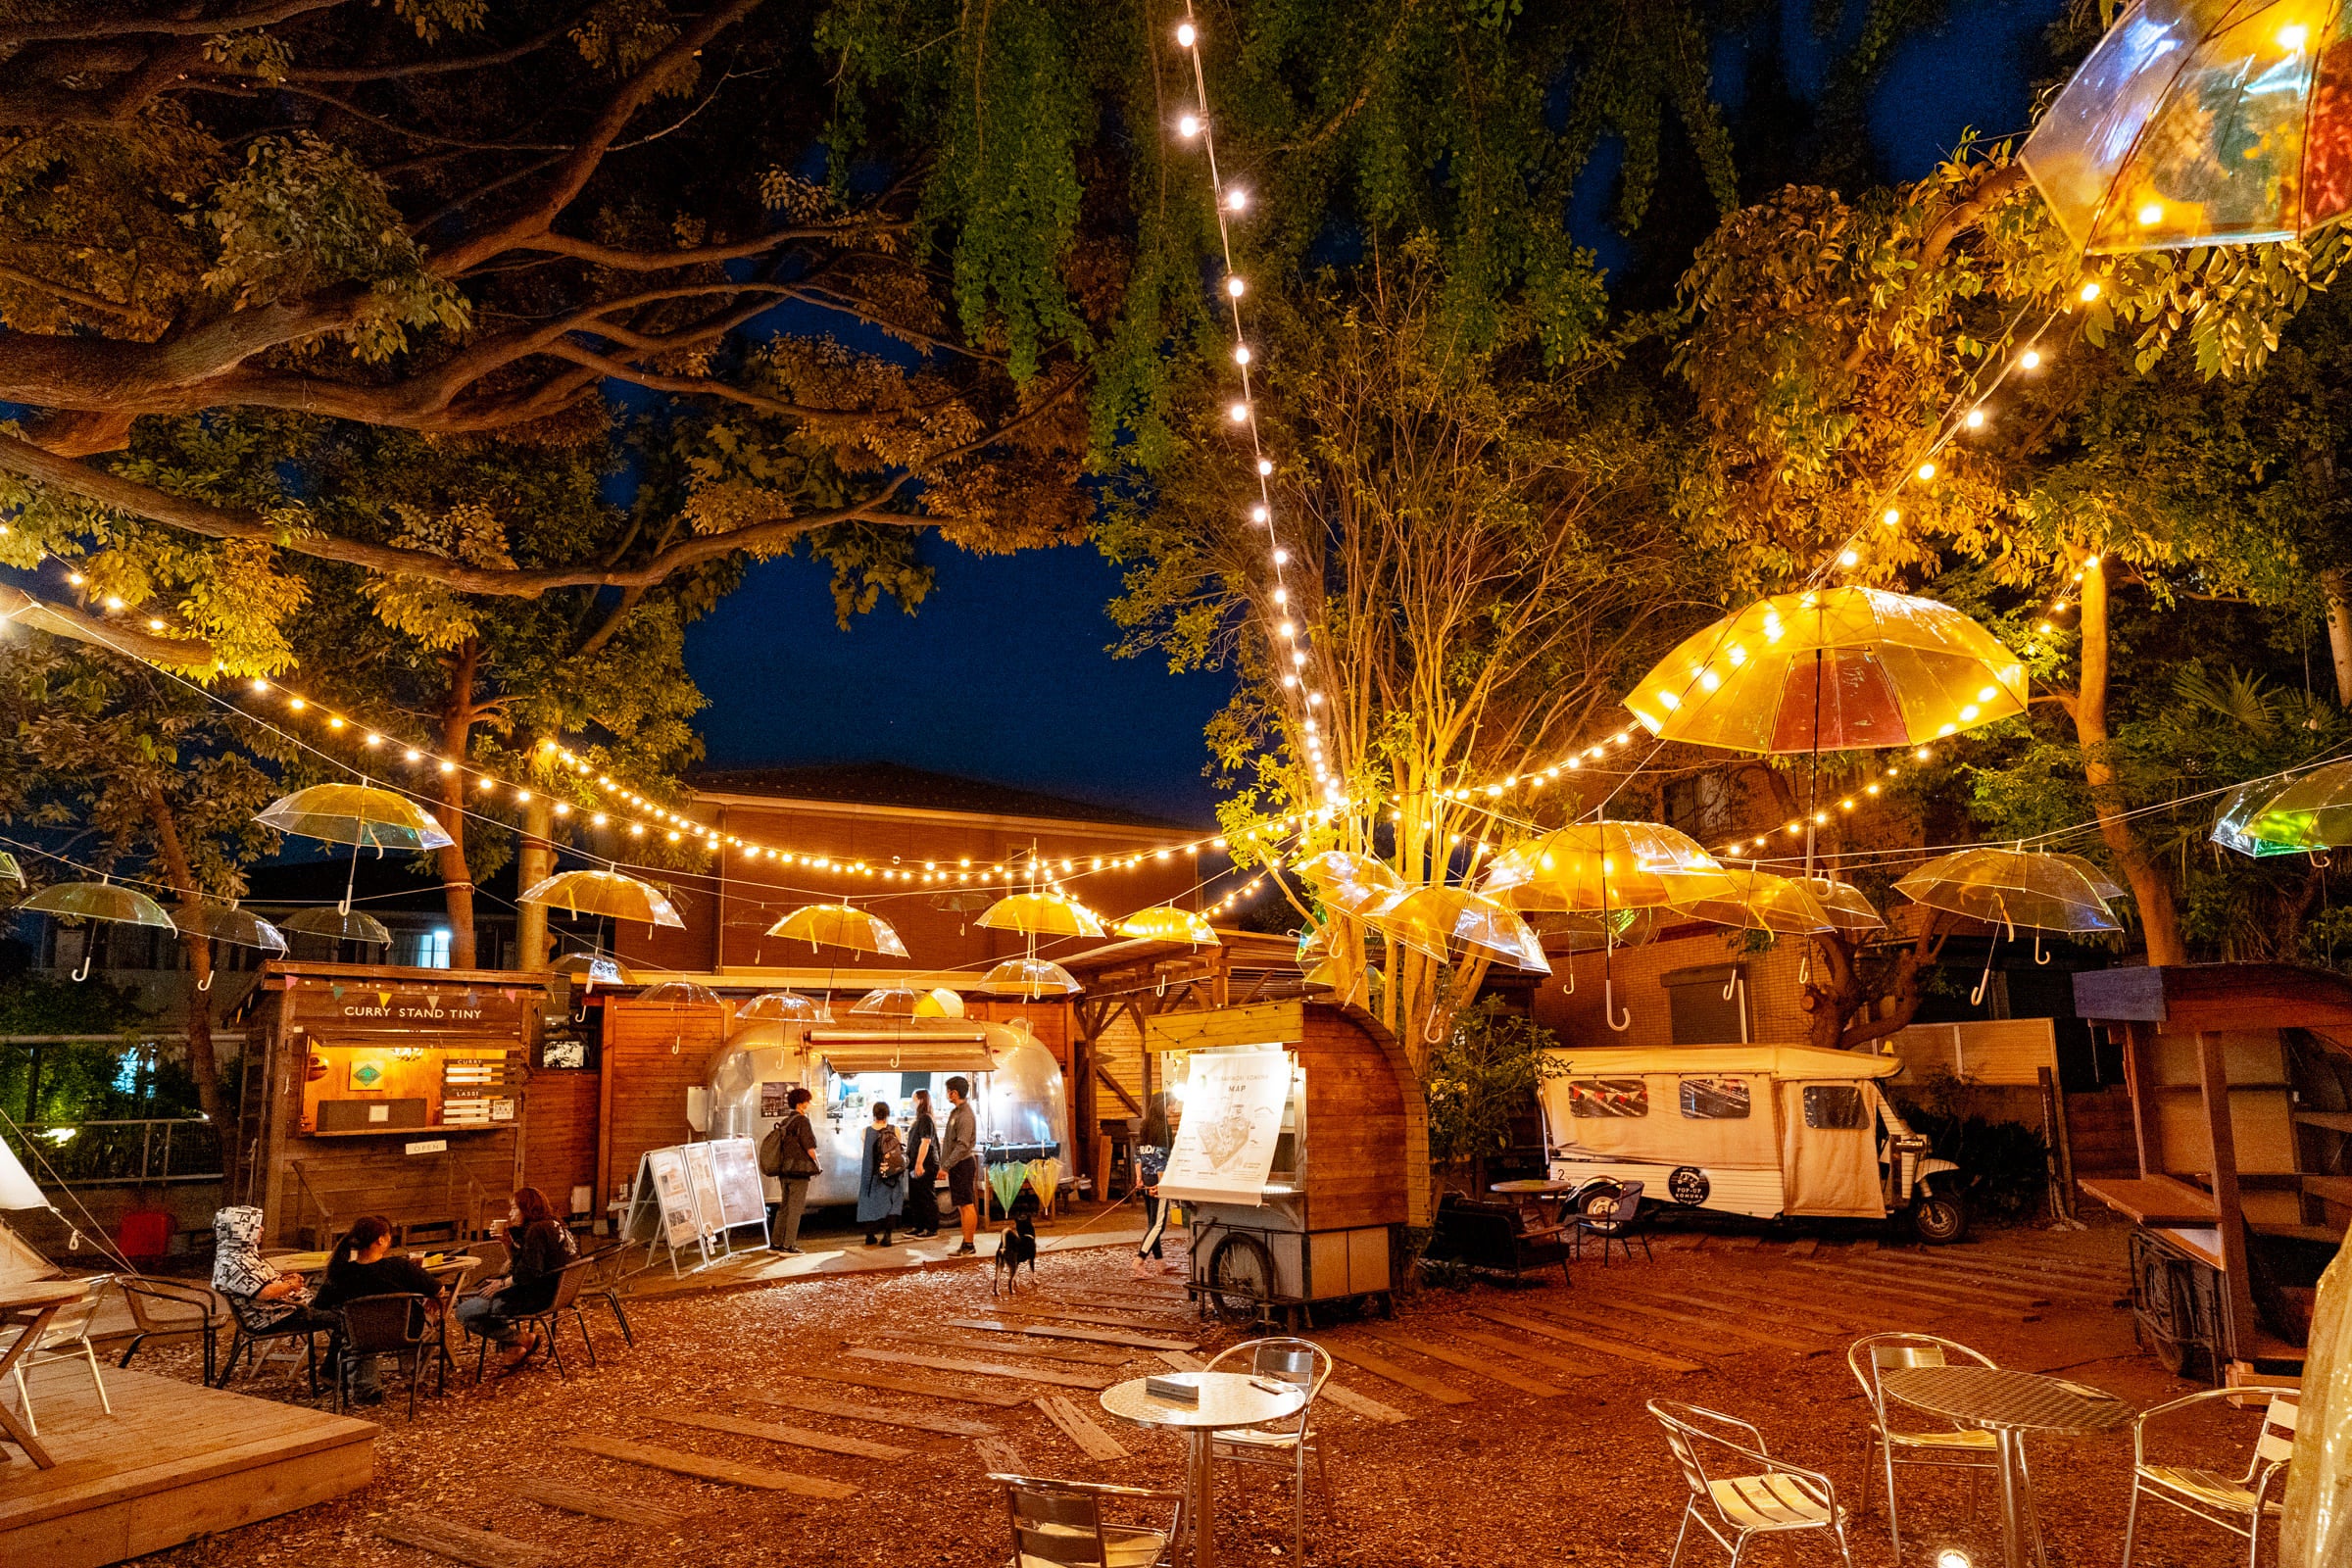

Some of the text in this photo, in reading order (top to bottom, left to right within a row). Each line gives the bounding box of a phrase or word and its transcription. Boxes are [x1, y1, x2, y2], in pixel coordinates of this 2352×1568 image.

[344, 1006, 482, 1019] CURRY STAND TINY
[1558, 1169, 1565, 1181] 2
